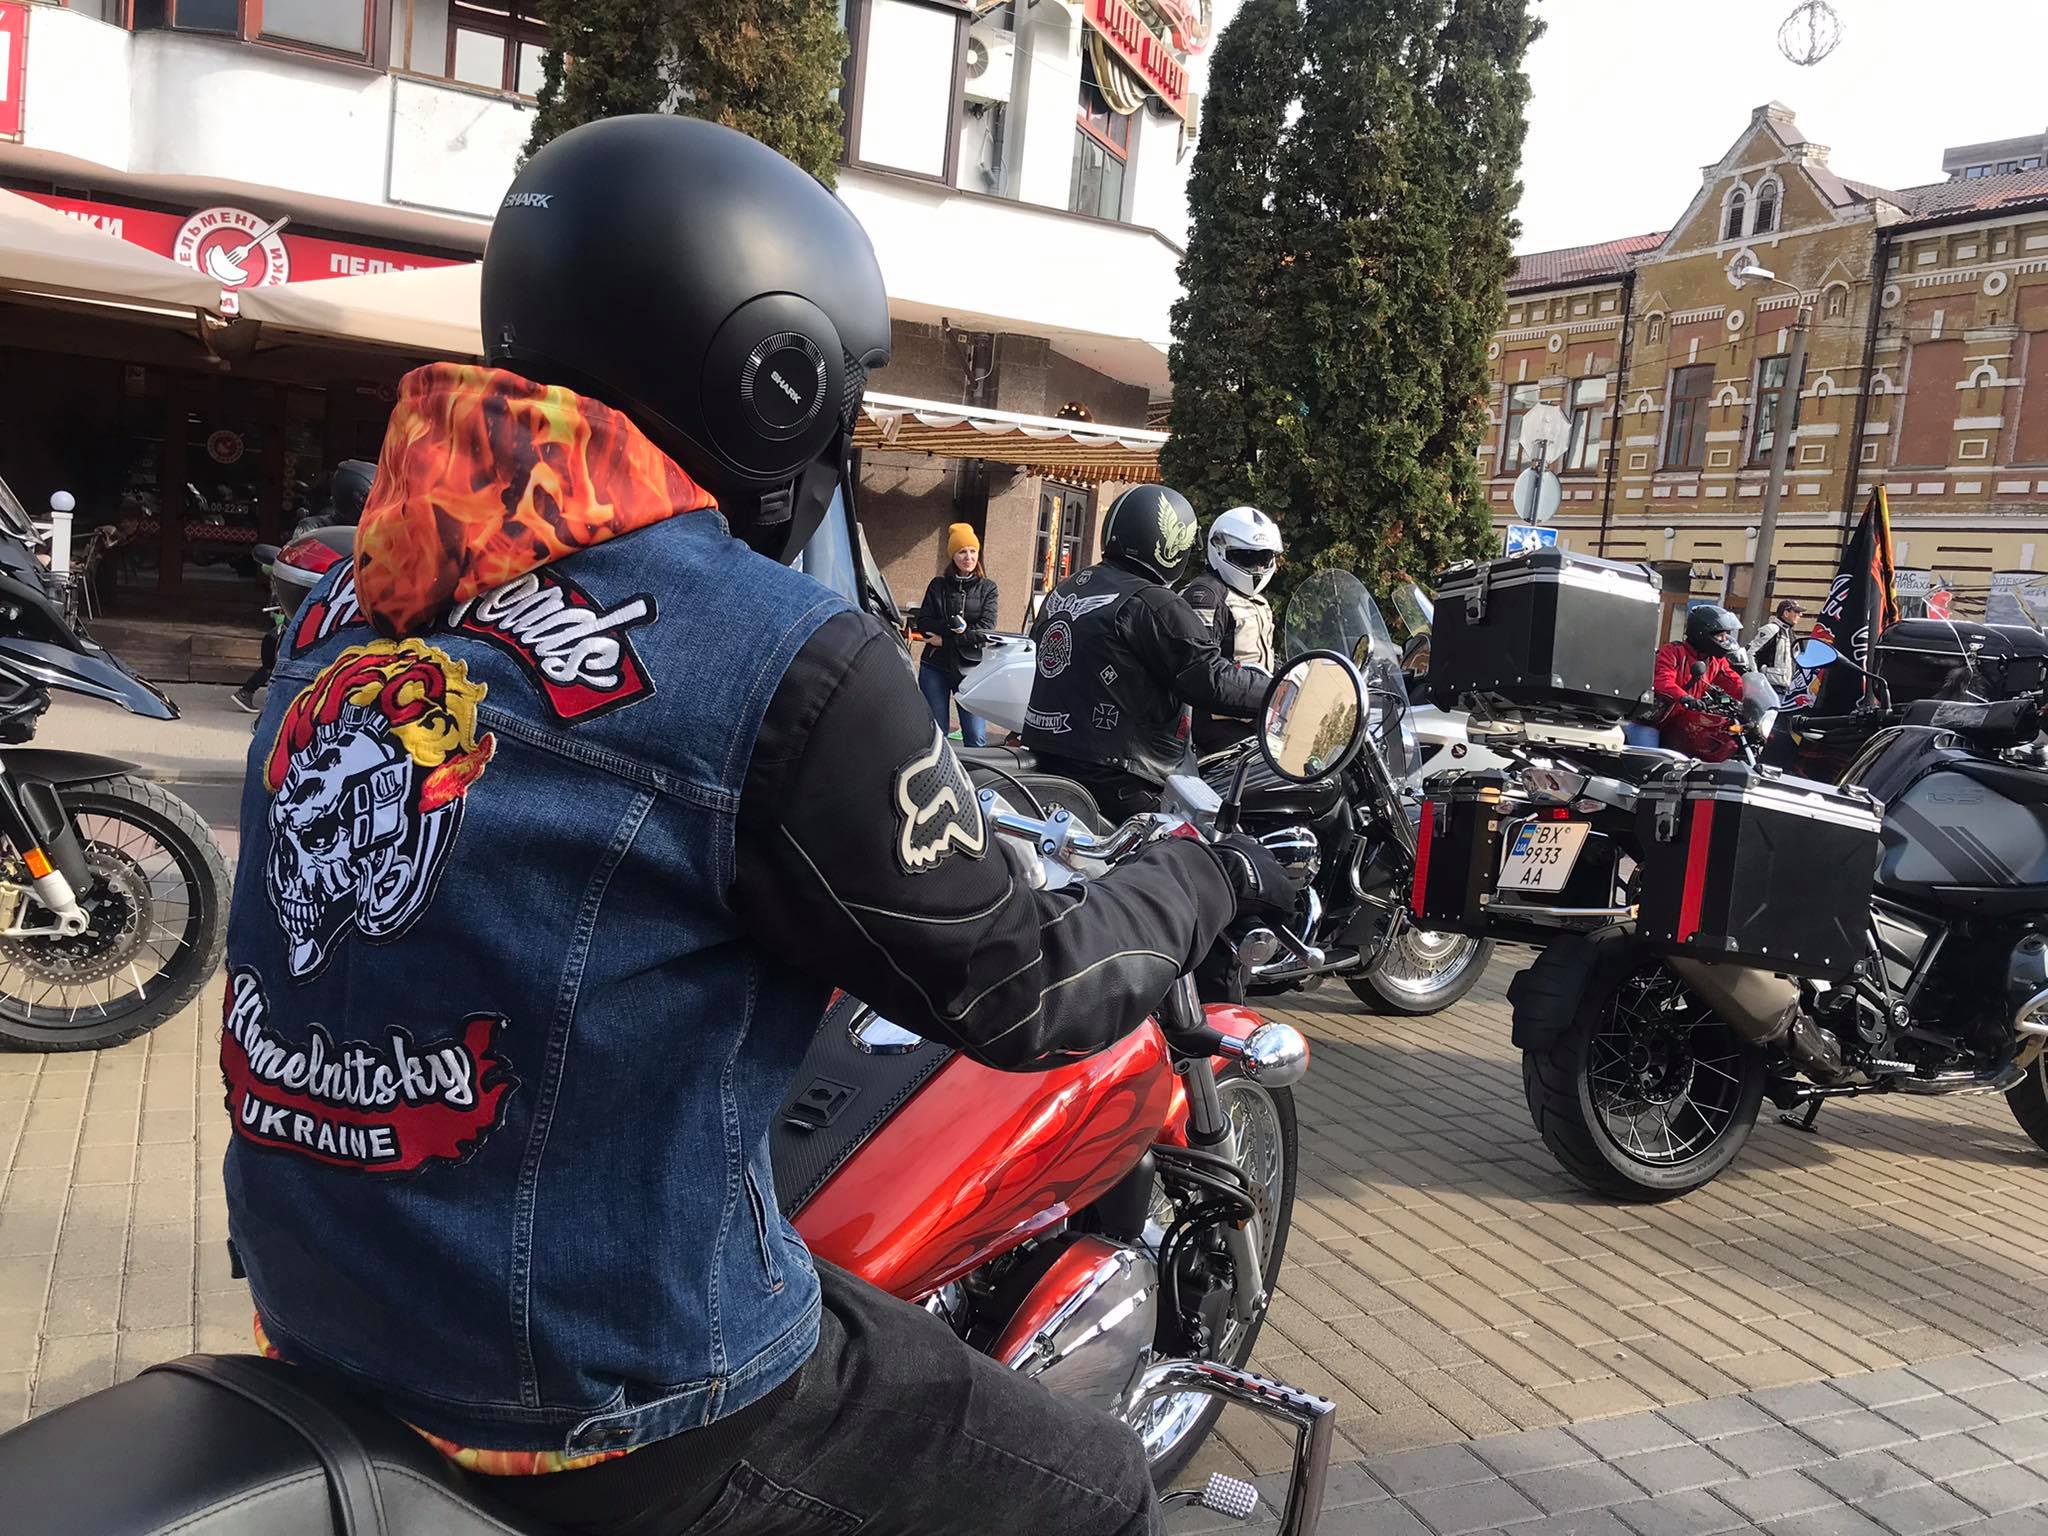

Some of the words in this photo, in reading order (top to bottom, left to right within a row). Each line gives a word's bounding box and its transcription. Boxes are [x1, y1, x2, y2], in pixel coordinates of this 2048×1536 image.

[503, 192, 554, 209] SHARK
[180, 212, 257, 263] ЕЛЬМЕНІ
[771, 370, 801, 404] SHARK
[1537, 827, 1564, 844] BX
[1515, 843, 1527, 852] UA
[1522, 847, 1562, 865] 9933
[1519, 867, 1543, 886] AA
[228, 973, 474, 1106] Khmelnitsky
[241, 1092, 396, 1160] UKRAINE
